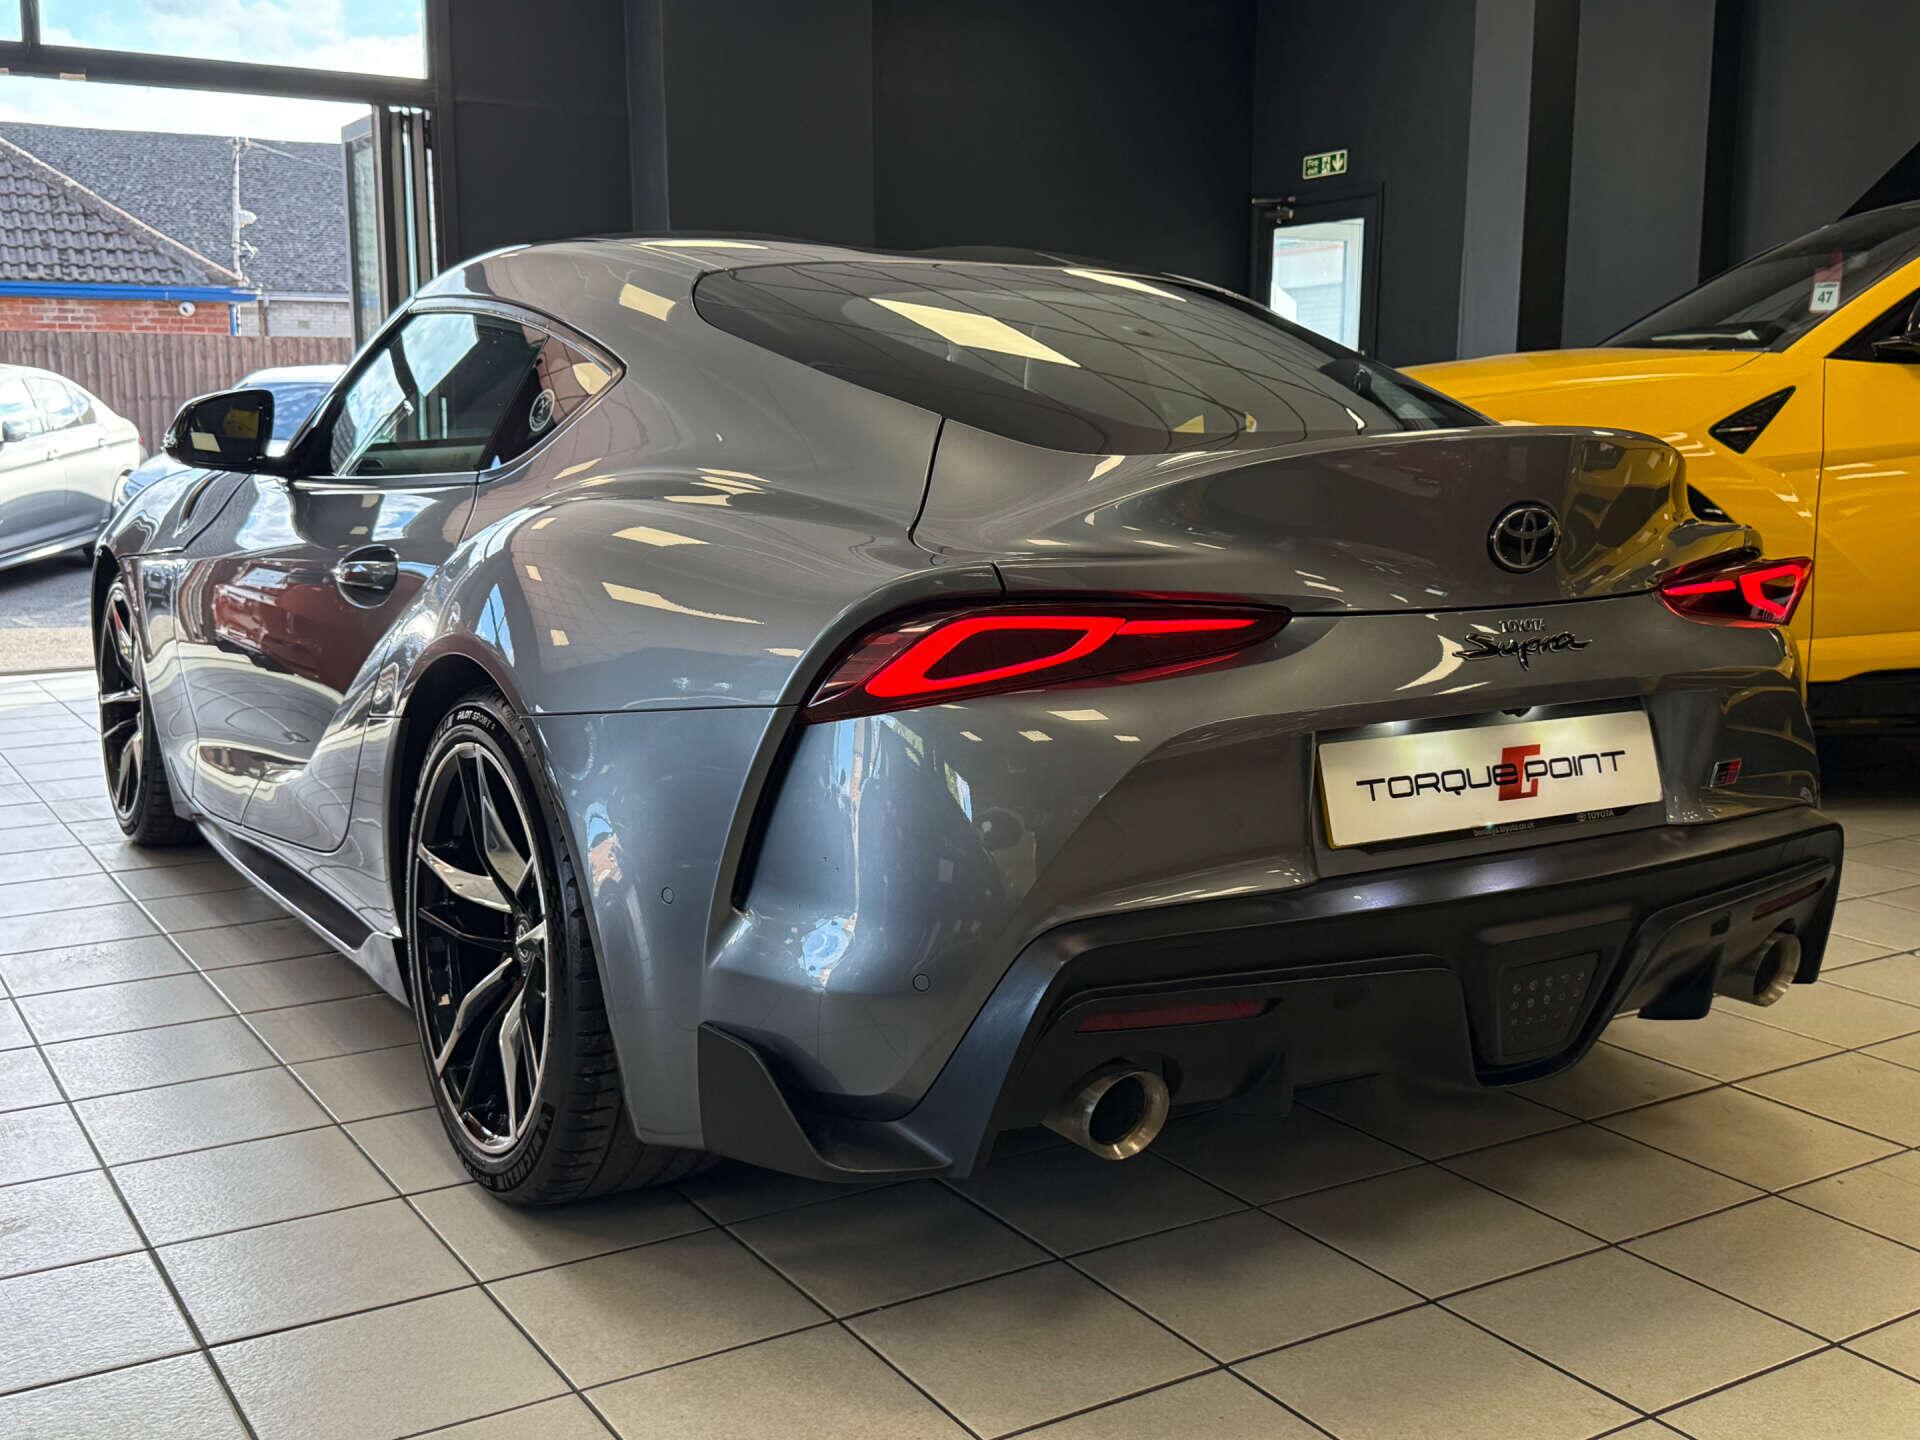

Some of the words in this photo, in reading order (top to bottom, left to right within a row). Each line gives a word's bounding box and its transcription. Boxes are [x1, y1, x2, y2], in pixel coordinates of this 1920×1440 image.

[1817, 291, 1833, 303] 47
[1499, 618, 1546, 633] TOYOTA
[1452, 631, 1593, 671] Supra
[457, 710, 473, 721] PILOT
[472, 711, 492, 728] SPORT
[1356, 763, 1519, 801] TORQUE
[1524, 750, 1626, 782] POINT
[1587, 808, 1616, 822] TOYOTA
